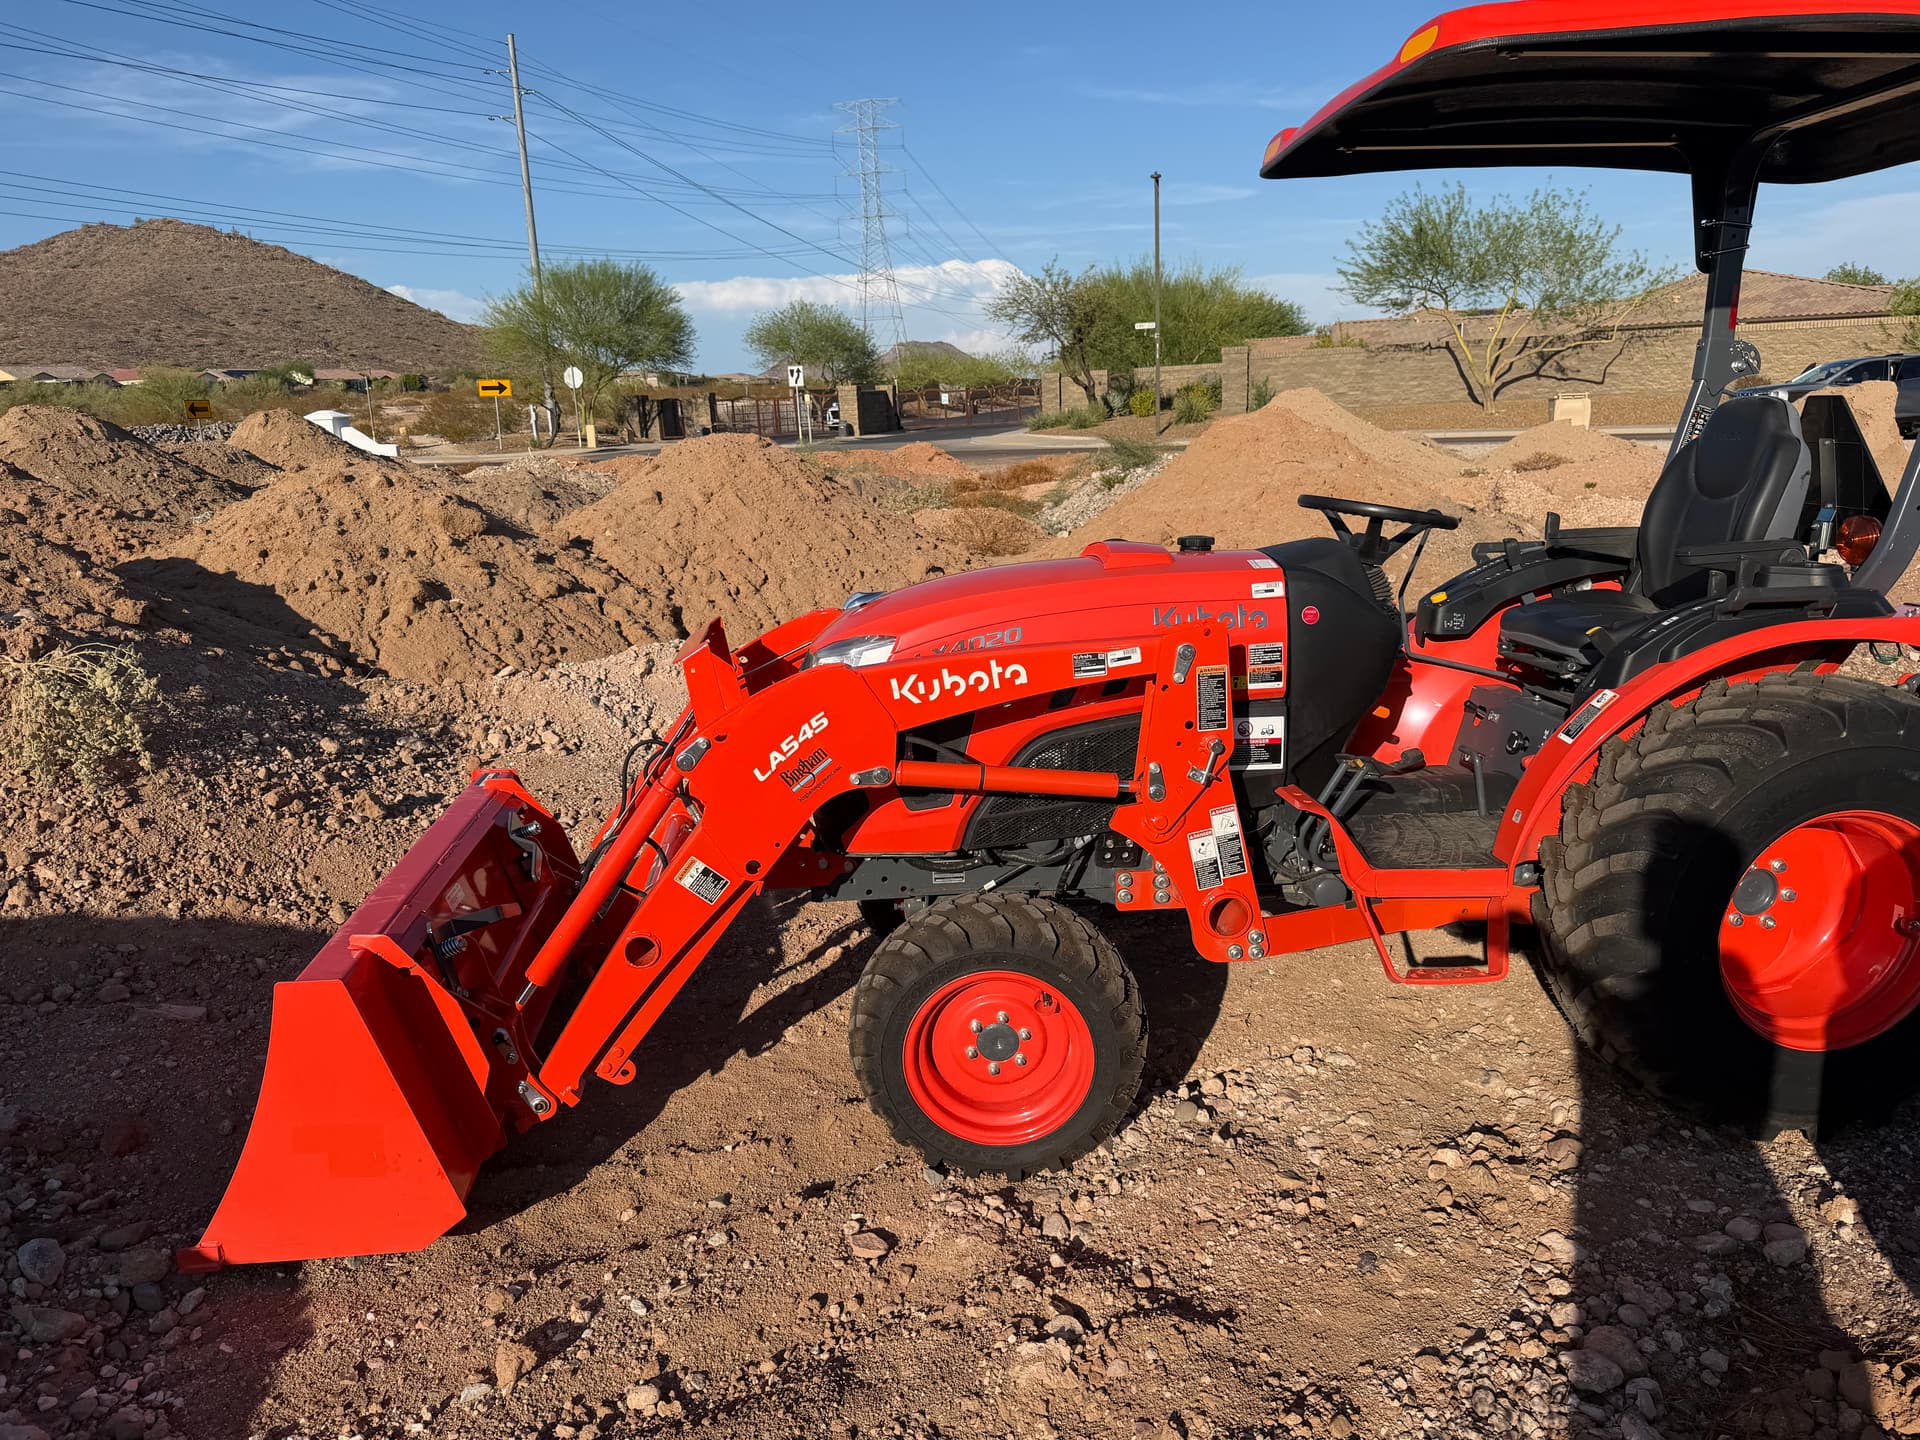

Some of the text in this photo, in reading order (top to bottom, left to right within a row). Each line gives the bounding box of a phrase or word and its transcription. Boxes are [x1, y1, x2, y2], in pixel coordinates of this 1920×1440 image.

[890, 659, 1028, 704] Kubota
[752, 711, 829, 782] LA545
[779, 747, 828, 788] Bingham
